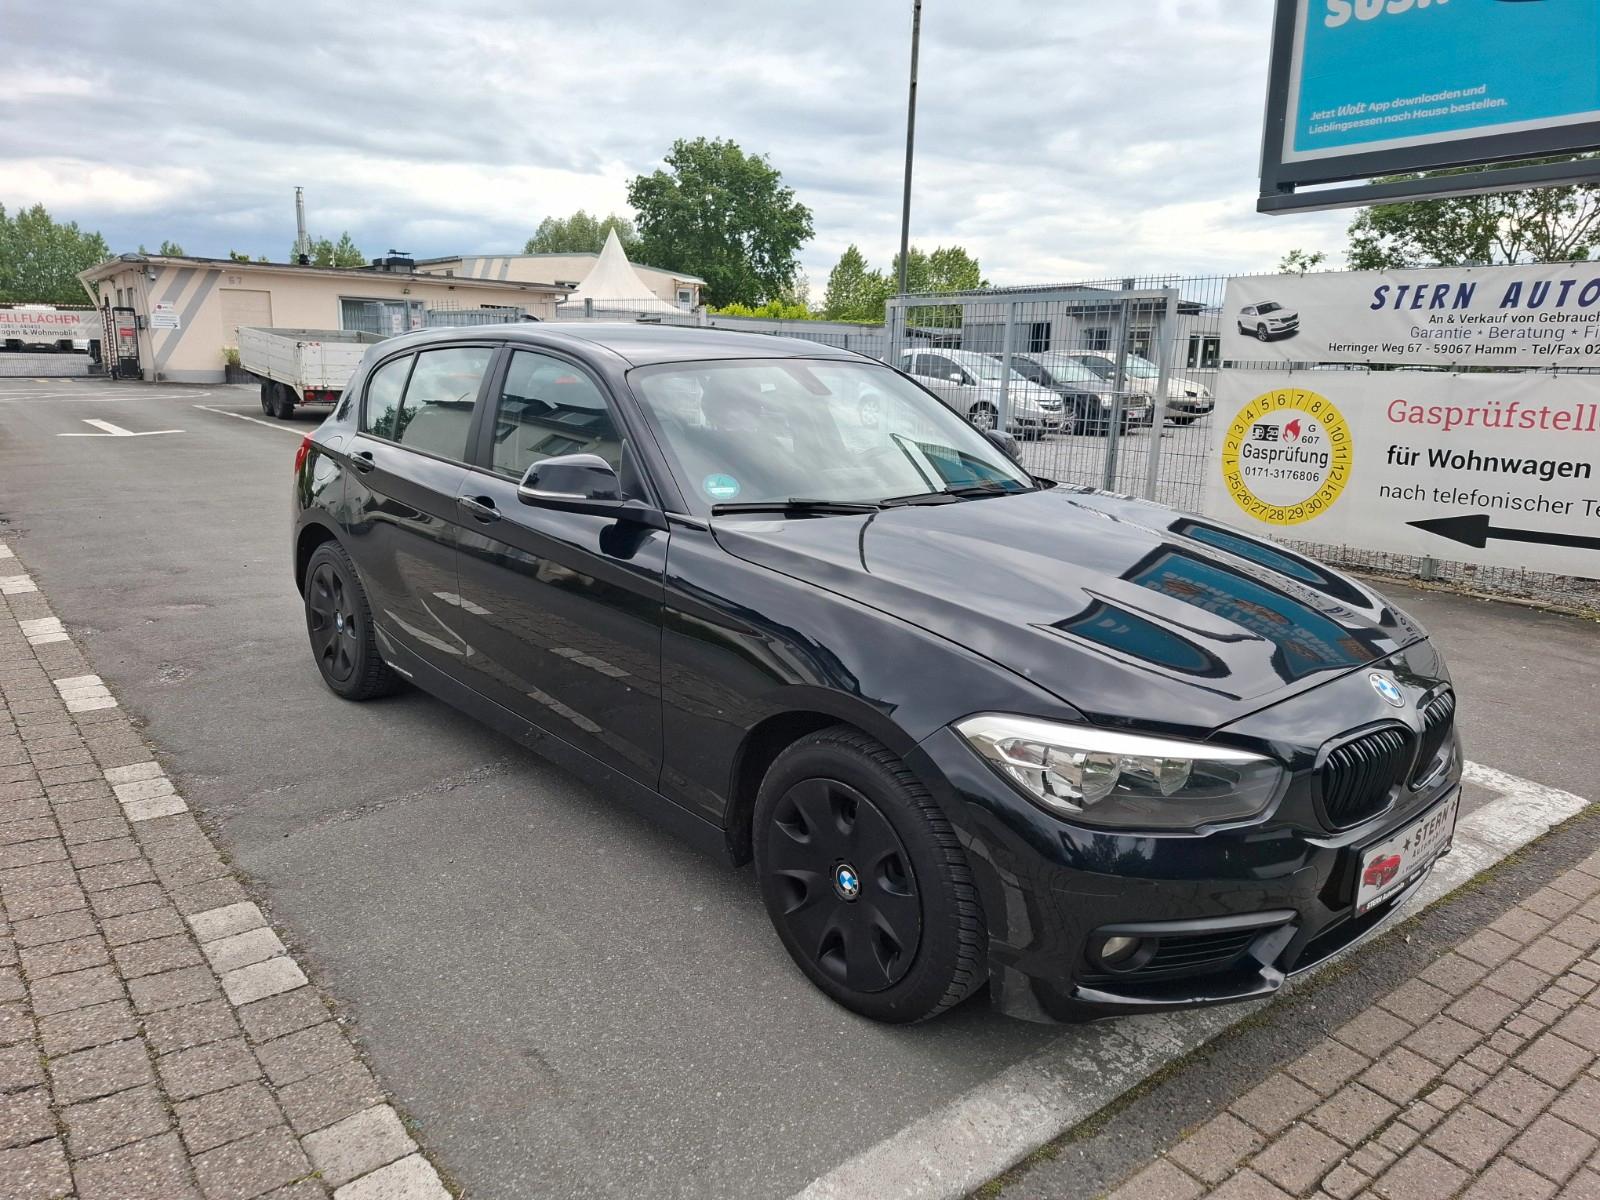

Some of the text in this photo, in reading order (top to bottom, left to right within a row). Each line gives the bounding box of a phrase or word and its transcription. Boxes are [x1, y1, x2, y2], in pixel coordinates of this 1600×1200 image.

[1310, 84, 1487, 121] Jetzt Wolt App downloaden und
[1308, 98, 1508, 135] Lieblingsessen nach Hause bestellen.
[1370, 282, 1477, 310] STERN
[1428, 314, 1444, 324] An
[1446, 314, 1454, 324] &
[1459, 312, 1508, 324] Verkauf
[1511, 314, 1535, 323] von
[1410, 326, 1472, 339] Garantie
[1488, 326, 1565, 341] Beratung
[1328, 342, 1379, 353] Herringer
[1381, 343, 1405, 355] Weg
[1407, 344, 1422, 353] 67
[1433, 344, 1471, 354] 59067
[1475, 344, 1517, 355] Hamm
[1532, 343, 1581, 355] Tel/Fax
[1261, 398, 1270, 410] 5
[1277, 394, 1286, 405] 6
[1296, 395, 1304, 405] 7
[1311, 401, 1321, 412] 8
[1246, 410, 1254, 421] 4
[1323, 413, 1334, 424] 9
[1387, 399, 1600, 432] Gasprüfstell
[1234, 424, 1244, 434] 3
[1308, 424, 1316, 433] G
[1330, 426, 1345, 442] 10
[1228, 441, 1238, 450] 2
[1301, 436, 1320, 444] 607
[1242, 443, 1329, 468] Gasprüfung
[1336, 446, 1347, 459] 11
[1387, 444, 1591, 481] für Wohnwagen
[1245, 466, 1320, 482] 0171-3176806
[1330, 464, 1345, 480] 12
[1228, 473, 1241, 490] 25
[1237, 490, 1252, 505] 26
[1321, 484, 1337, 500] 31
[1306, 498, 1322, 514] 30
[1379, 484, 1426, 501] nach
[1433, 487, 1574, 515] telefonischer
[1251, 501, 1267, 515] 27
[1268, 508, 1284, 520] 28
[1287, 507, 1304, 520] 29
[1414, 804, 1450, 847] STERN
